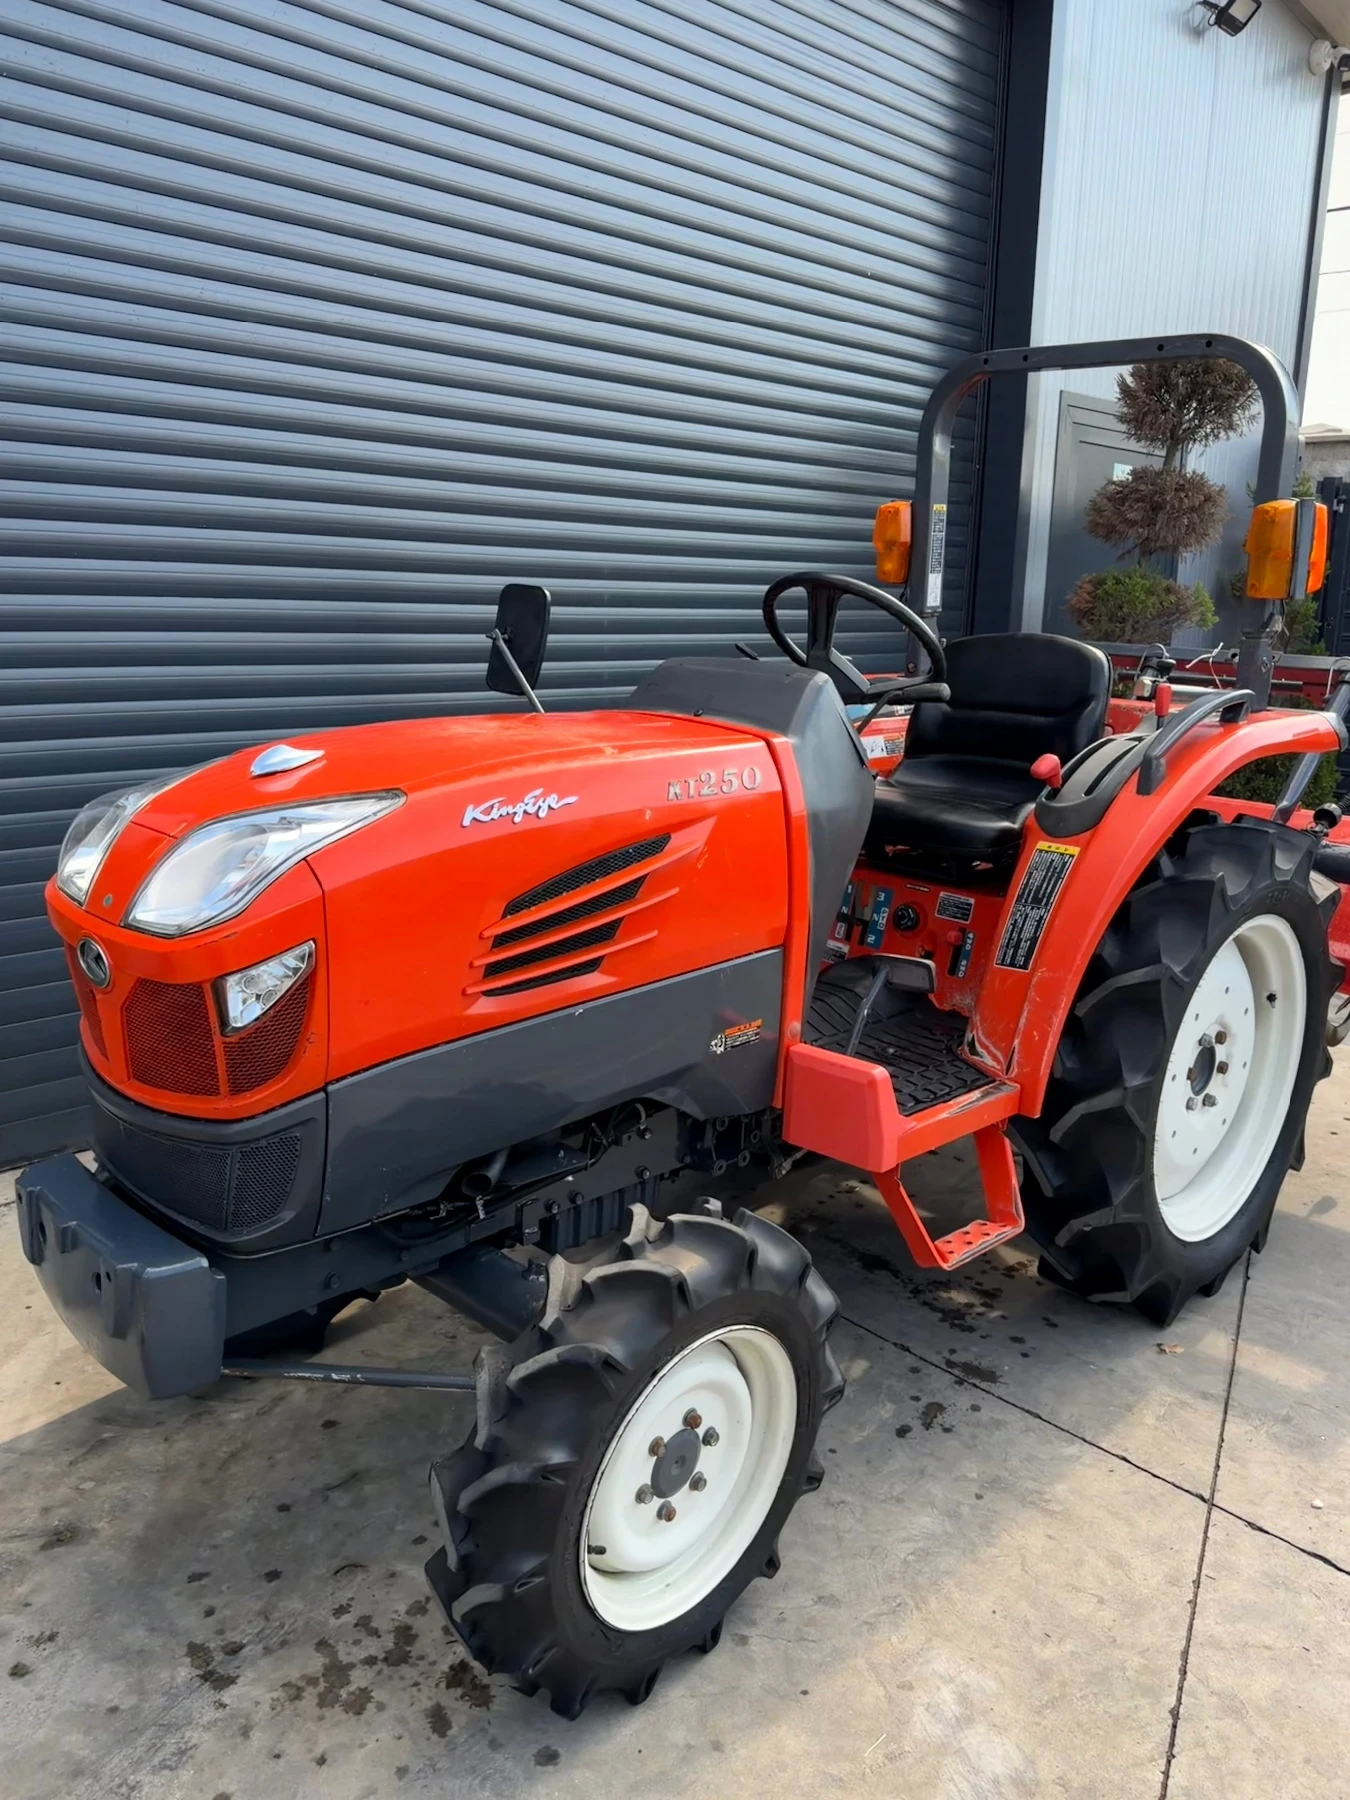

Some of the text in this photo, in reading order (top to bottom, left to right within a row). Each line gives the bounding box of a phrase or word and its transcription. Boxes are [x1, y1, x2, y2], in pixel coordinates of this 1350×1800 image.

[667, 767, 762, 801] KT250
[877, 891, 886, 901] 3
[867, 934, 876, 944] 2
